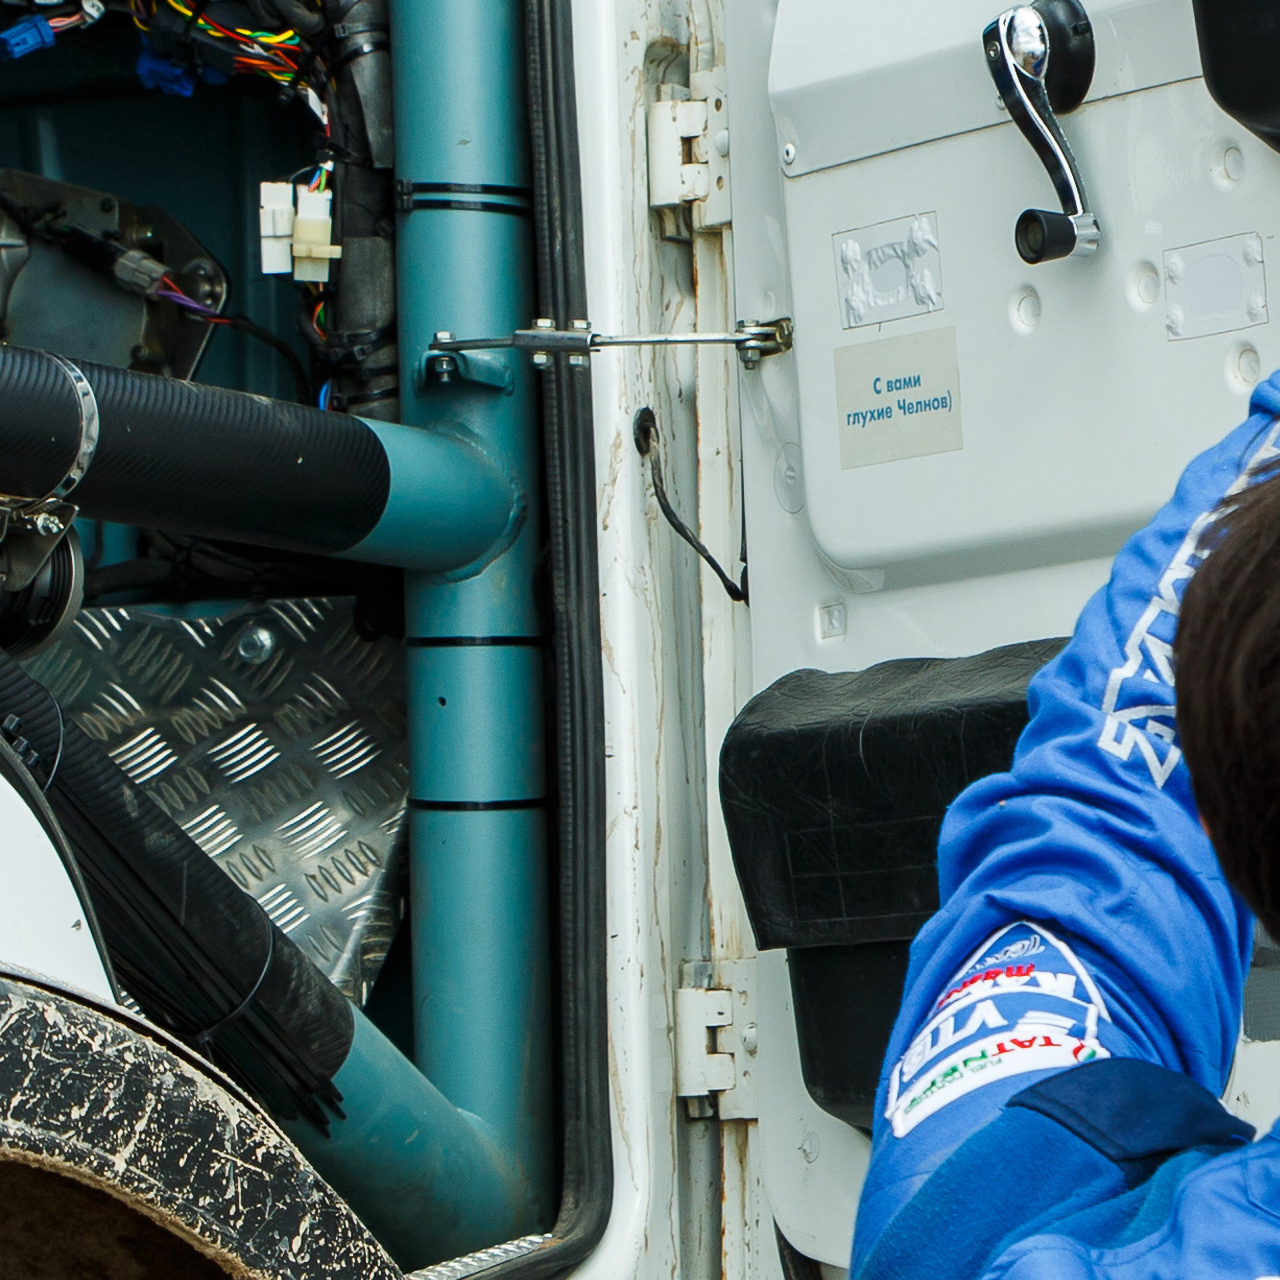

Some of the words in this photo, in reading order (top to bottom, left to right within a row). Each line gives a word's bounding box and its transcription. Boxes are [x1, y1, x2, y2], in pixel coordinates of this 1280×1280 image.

[873, 377, 882, 394] С
[886, 375, 922, 393] вами
[846, 406, 893, 429] глухие
[897, 389, 952, 416] Челнов)
[901, 999, 1010, 1084] VTB
